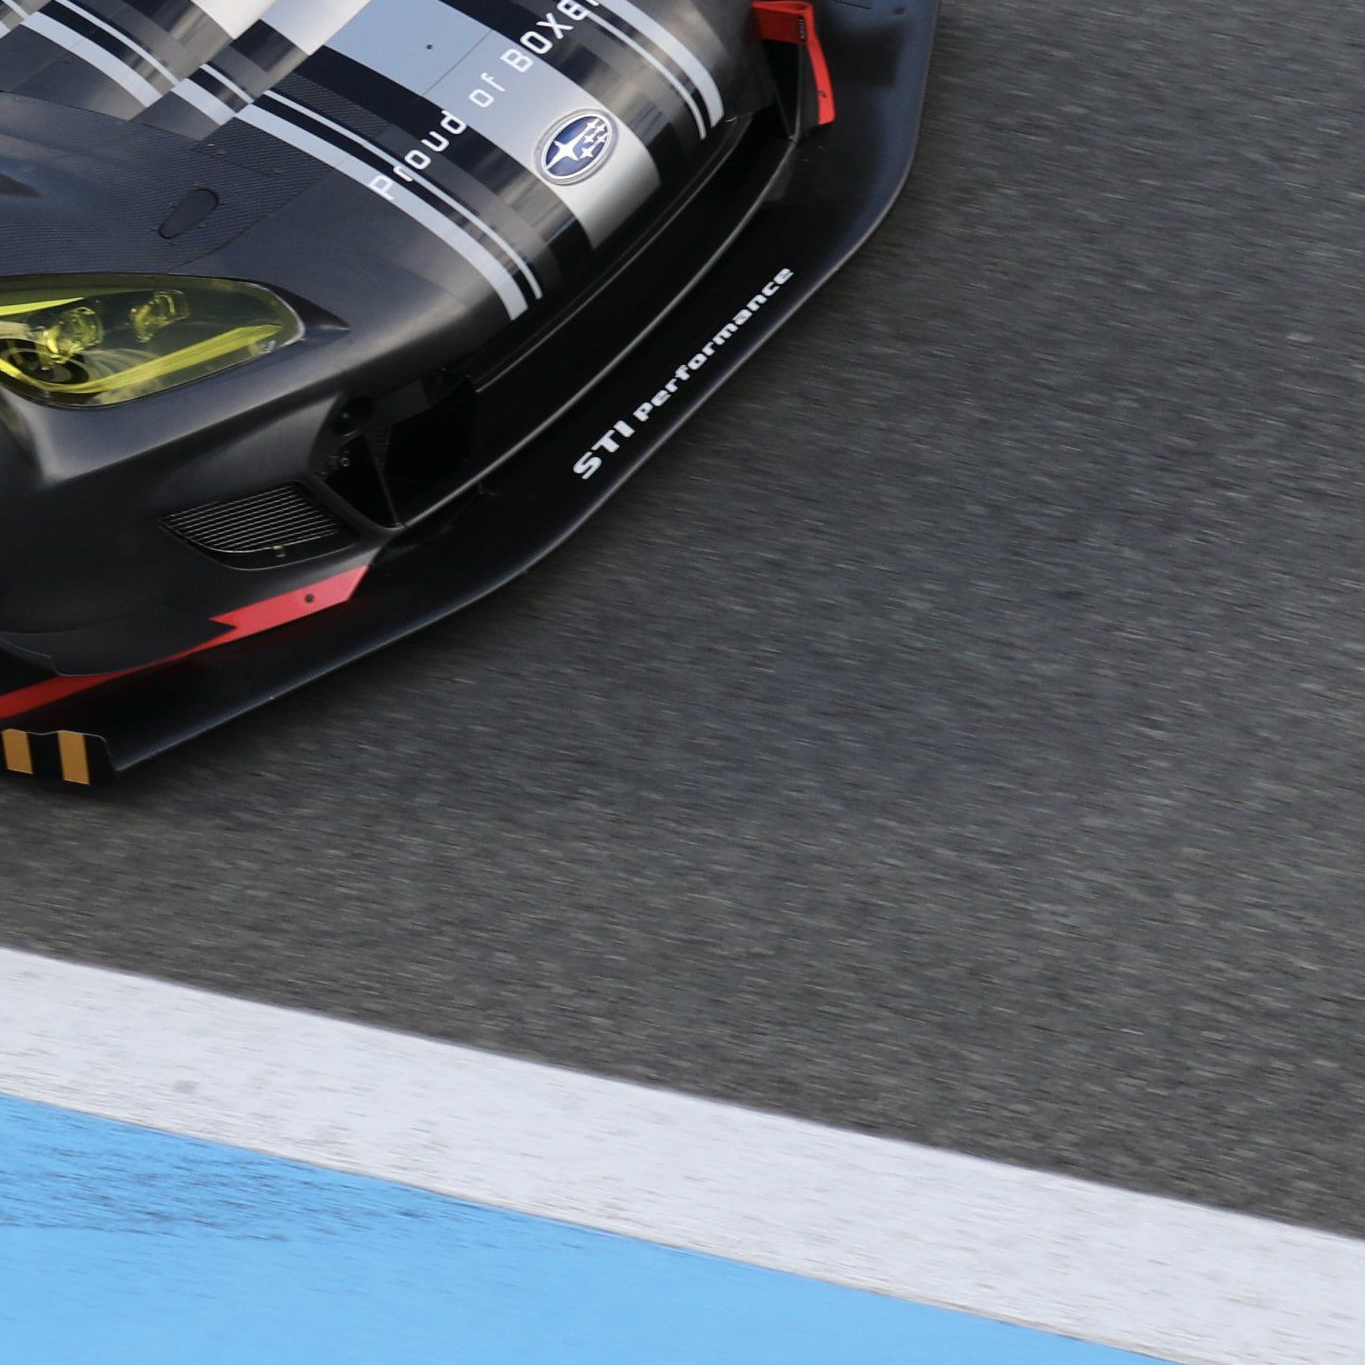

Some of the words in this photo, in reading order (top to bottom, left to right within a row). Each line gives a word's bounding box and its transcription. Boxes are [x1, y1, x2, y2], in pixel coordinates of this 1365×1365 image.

[369, 111, 467, 202] Proud
[468, 72, 506, 109] of
[572, 420, 635, 480] STI
[632, 267, 794, 422] Performance
